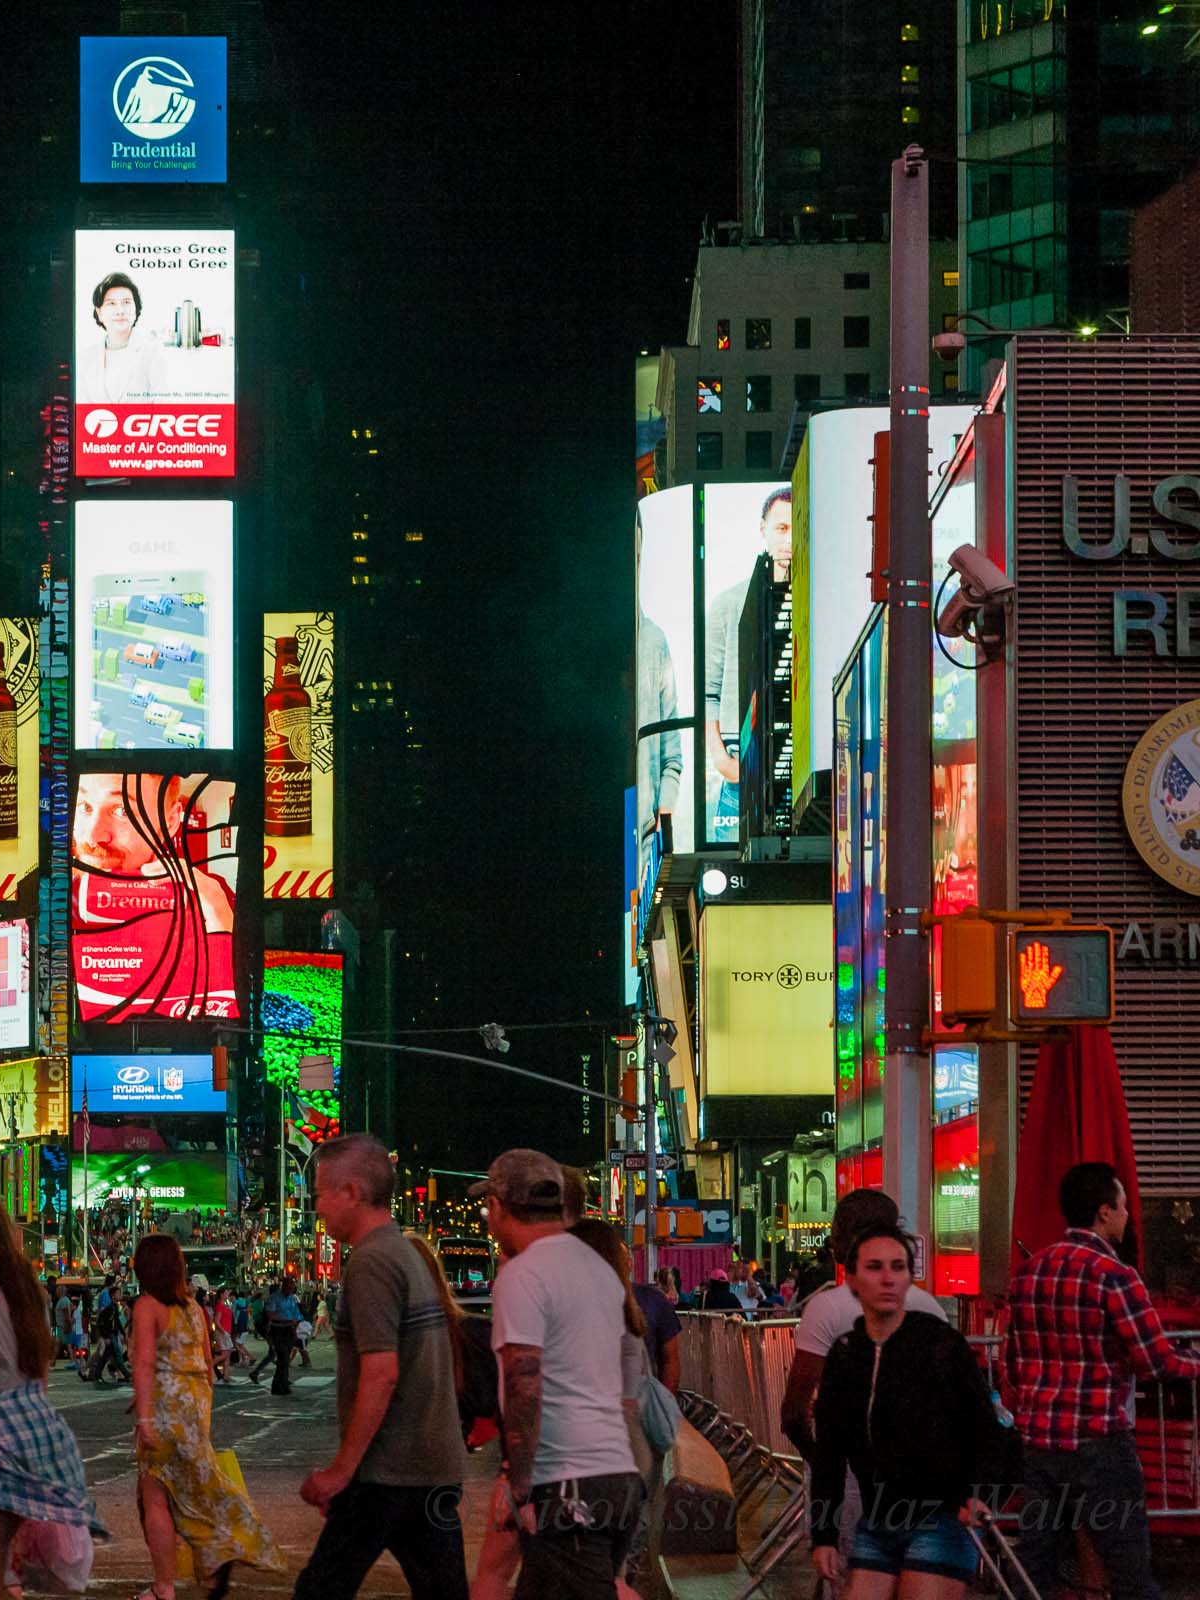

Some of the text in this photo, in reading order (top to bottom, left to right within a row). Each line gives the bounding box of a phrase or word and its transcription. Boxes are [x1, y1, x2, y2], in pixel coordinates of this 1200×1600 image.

[112, 141, 196, 158] Prudential
[111, 160, 196, 171] Bring Your Challenges
[115, 243, 227, 254] Chinese Gree
[129, 258, 227, 269] Global Gree
[123, 414, 222, 437] GREE
[83, 442, 226, 456] Master of Air Conditioning
[109, 459, 203, 470] www.gree.com
[81, 956, 143, 969] Dreamer
[731, 972, 774, 982] TORY
[113, 1085, 154, 1093] HYUNDAI
[581, 1055, 590, 1134] WELLNGTON
[150, 1187, 185, 1197] GENESIS
